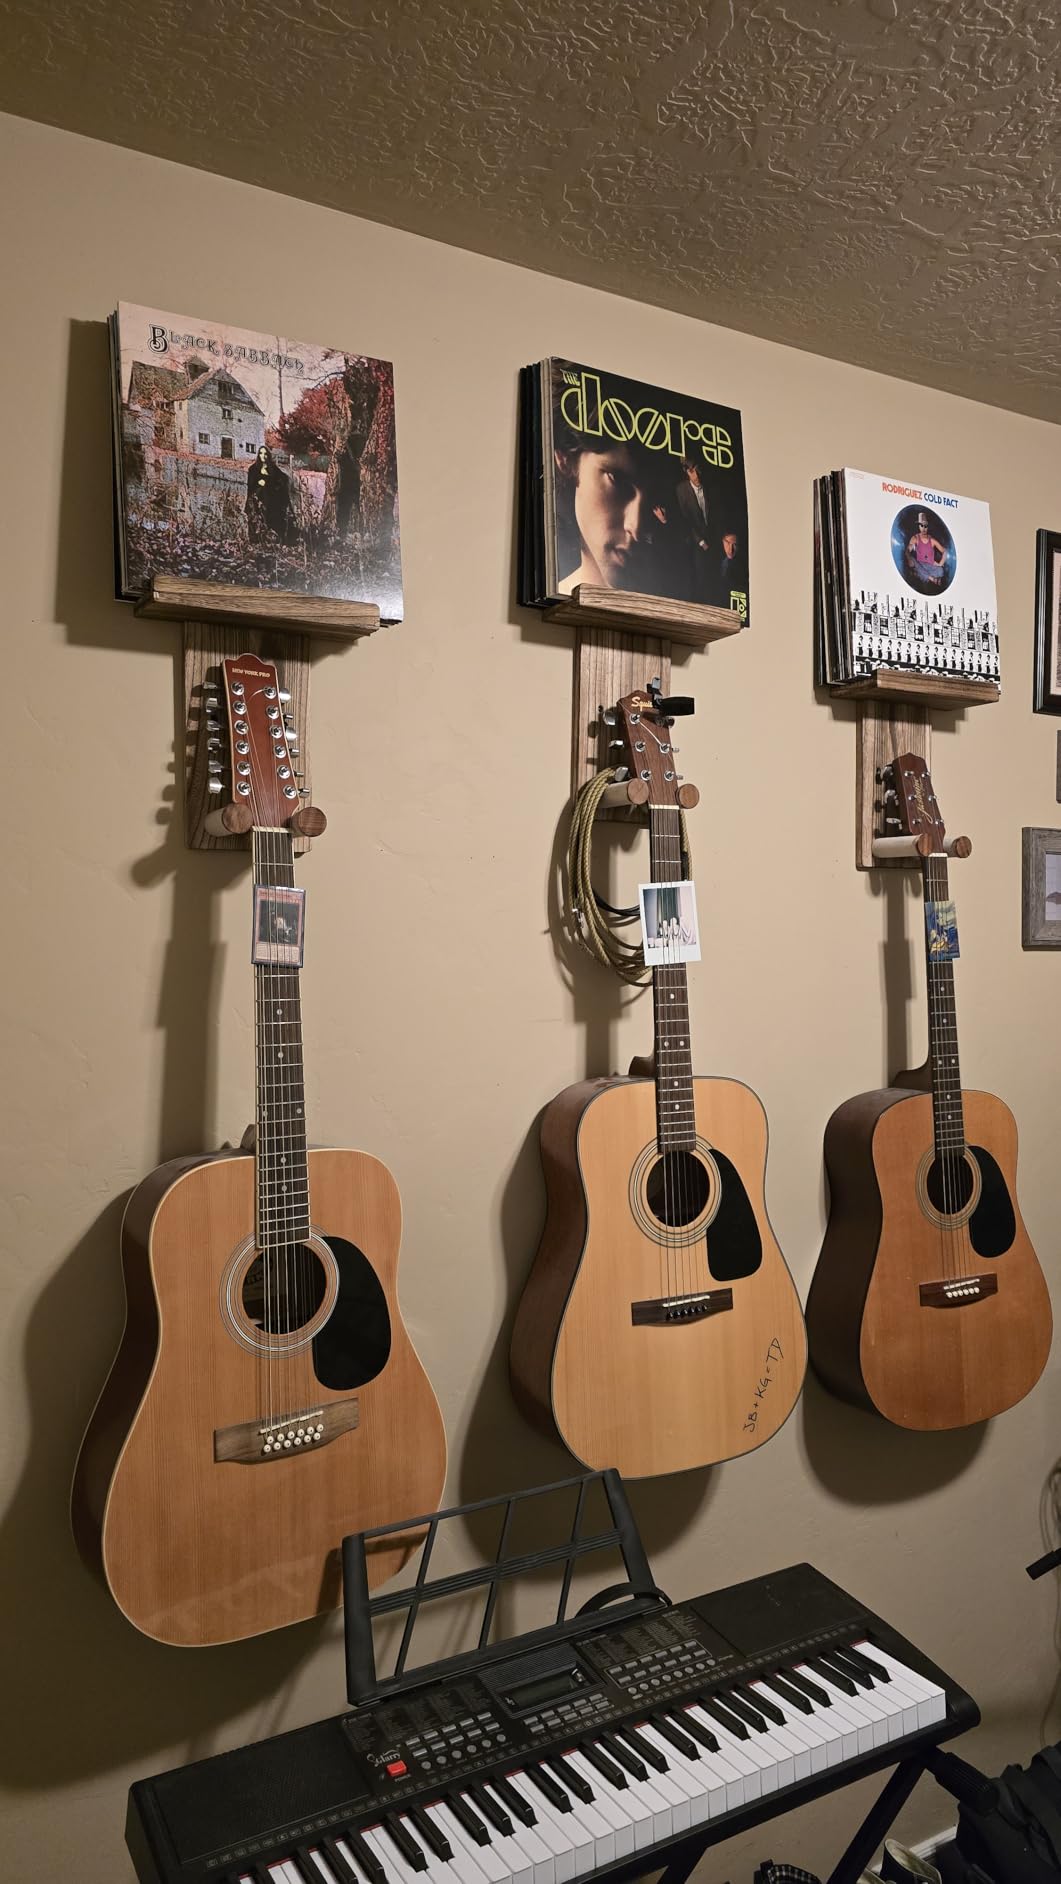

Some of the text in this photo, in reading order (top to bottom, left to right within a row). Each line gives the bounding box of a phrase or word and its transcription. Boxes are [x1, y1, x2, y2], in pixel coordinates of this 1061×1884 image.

[882, 482, 959, 508] RODRIGUEZ COLD FACT
[244, 669, 258, 677] YORK
[742, 1411, 758, 1433] JB
[754, 1378, 773, 1399] KG
